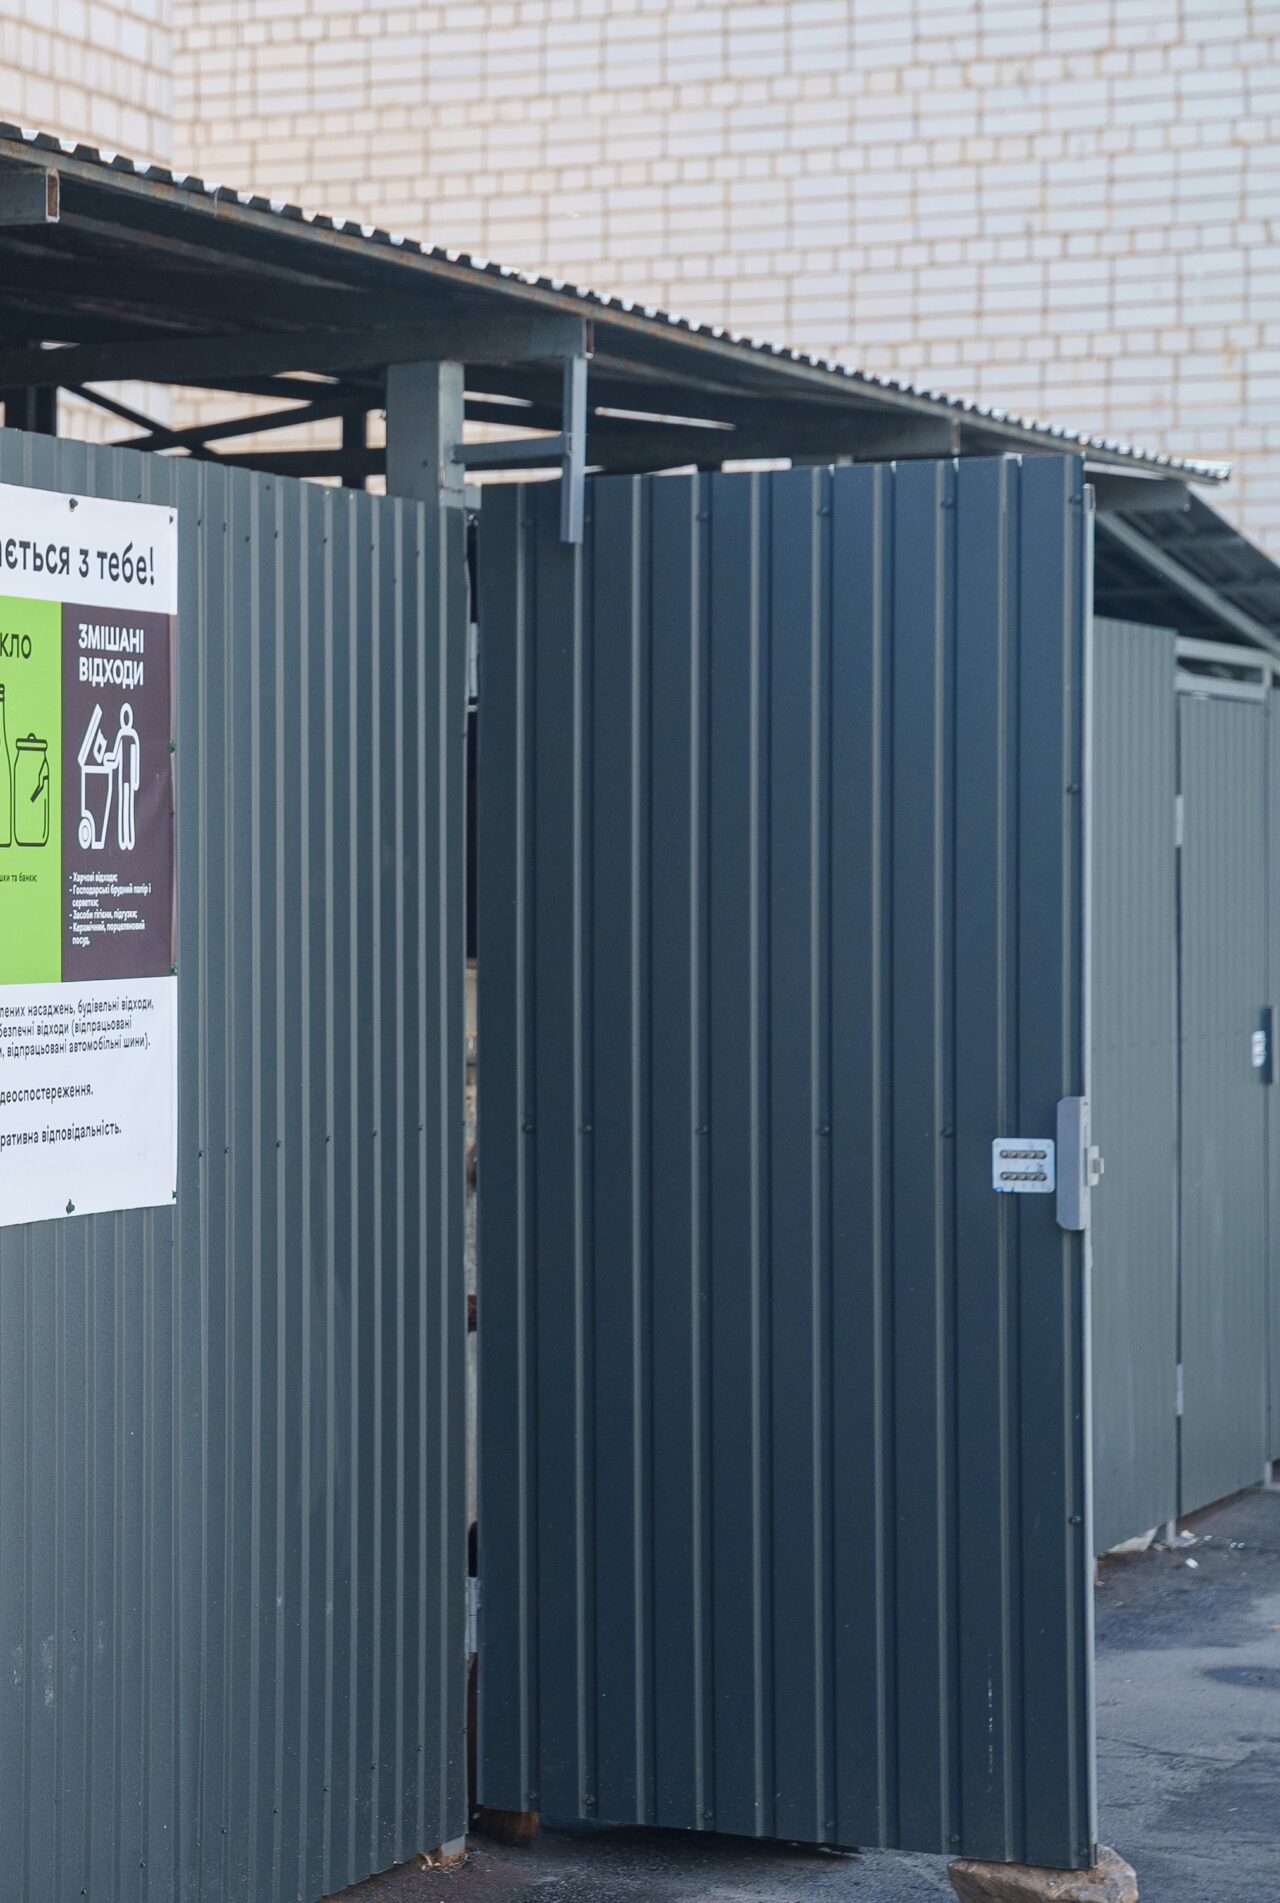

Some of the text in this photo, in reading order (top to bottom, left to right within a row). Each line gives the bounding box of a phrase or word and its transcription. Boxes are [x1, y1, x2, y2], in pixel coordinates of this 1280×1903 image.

[79, 552, 89, 577] з
[98, 541, 155, 585] тебе!
[78, 624, 145, 654] ЗМІШАНІ
[78, 657, 144, 690] ВІДХОДИ
[11, 874, 18, 882] та
[72, 871, 95, 884] Харчові
[72, 884, 110, 897] Господарські
[110, 883, 133, 897] брудний
[133, 883, 148, 896] папір
[72, 909, 93, 920] Засоби
[72, 920, 106, 935] Керамічний,
[27, 1003, 76, 1018] насаджень,
[77, 997, 120, 1018] будівельні
[121, 996, 154, 1011] відходи,
[36, 1019, 69, 1037] відходи
[70, 1014, 132, 1037] (відпрацьовані
[7, 1038, 67, 1060] відпрацьовані
[68, 1033, 122, 1053] автомобільні
[123, 1032, 151, 1050] шини).
[41, 1119, 122, 1146] відповідальність.
